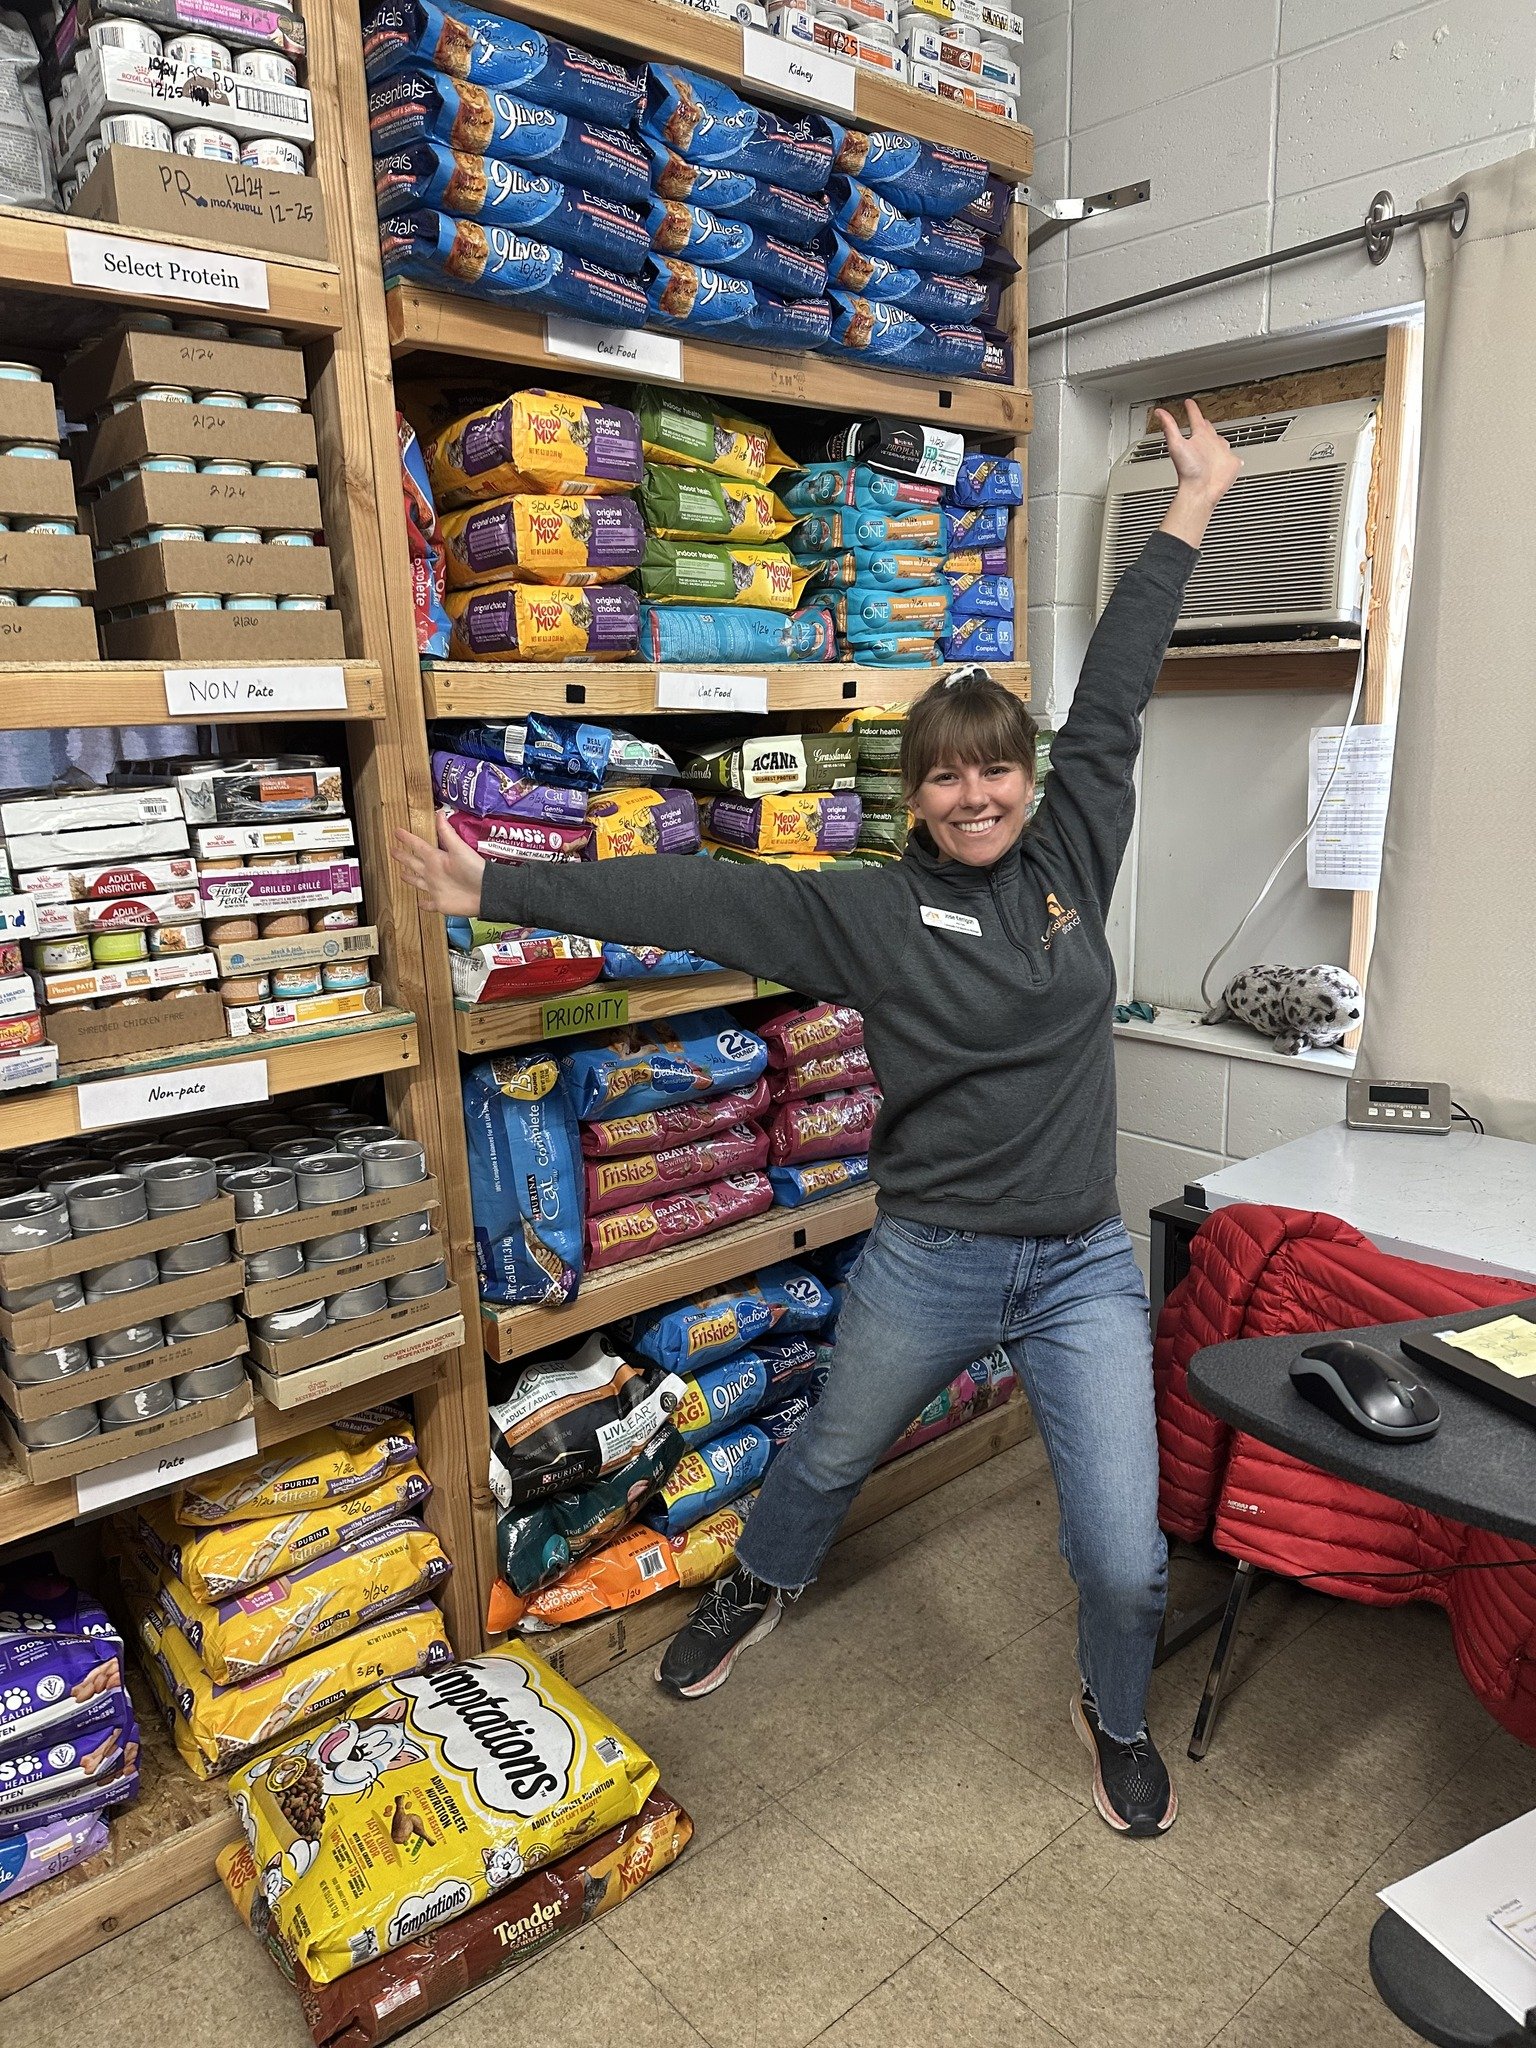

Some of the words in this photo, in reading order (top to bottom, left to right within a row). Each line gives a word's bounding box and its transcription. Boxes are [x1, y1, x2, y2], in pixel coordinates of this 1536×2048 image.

[788, 62, 814, 82] Kidney
[370, 79, 428, 112] Essentials
[493, 93, 556, 140] 9Lives
[490, 160, 550, 206] 9Lives
[695, 207, 743, 244] 9Lives
[491, 228, 551, 273] 9Lives
[103, 252, 163, 280] Select
[168, 261, 240, 290] Protein
[700, 267, 749, 306] 9Lives
[597, 341, 614, 356] Cat
[616, 344, 637, 361] Food
[528, 410, 561, 430] Meow
[594, 418, 621, 429] original
[535, 428, 557, 446] Mix
[595, 426, 620, 437] choice
[871, 481, 895, 496] ONE
[530, 510, 562, 529] Meow
[596, 508, 622, 519] original
[597, 517, 621, 526] choice
[536, 528, 559, 546] Mix
[858, 524, 885, 539] ONE
[978, 533, 997, 541] Complete
[676, 549, 698, 559] indoor
[698, 551, 719, 560] health
[766, 557, 792, 579] Meow
[872, 561, 896, 575] ONE
[414, 558, 427, 607] omplete
[530, 601, 562, 618] Meow
[595, 596, 621, 606] original
[597, 604, 621, 613] choice
[975, 598, 998, 606] Complete
[863, 607, 889, 620] ONE
[536, 615, 559, 632] Mix
[189, 681, 240, 702] NON
[246, 684, 275, 698] Pate
[698, 686, 711, 698] Cat
[714, 687, 732, 698] Food
[859, 726, 879, 735] indoor
[879, 727, 900, 736] health
[587, 737, 602, 746] REAL
[752, 752, 798, 771] ACANA
[813, 748, 851, 763] Grasslands
[441, 759, 453, 791] PURINA
[777, 774, 798, 782] PROTEIN
[461, 769, 475, 805] Gentle
[545, 790, 563, 801] Cat
[544, 804, 563, 814] Gentle
[660, 809, 682, 821] original
[773, 807, 801, 826] Meow
[827, 806, 848, 815] original
[827, 813, 846, 822] choice
[872, 812, 892, 821] health
[662, 818, 682, 828] choice
[489, 825, 536, 843] IAMS
[608, 827, 634, 844] Meow
[488, 842, 514, 854] URINARY
[516, 849, 532, 858] TRACT
[532, 852, 550, 860] HEALTH
[108, 873, 135, 883] ADULT
[98, 882, 147, 894] INSTINCTIVE
[210, 884, 247, 897] Fancy
[260, 885, 291, 894] GRILLED
[298, 881, 321, 892] GRILLÉ
[102, 914, 151, 927] INSTINCTIVE
[112, 907, 139, 918] ADULT
[78, 1023, 119, 1036] SHREDDED
[124, 1016, 160, 1027] CHICKEN
[164, 1012, 185, 1020] FARE
[547, 1000, 623, 1031] PRIORITY
[719, 1033, 756, 1054] 22
[653, 1065, 692, 1078] Seafood
[148, 1082, 206, 1102] Non-pate
[509, 1073, 532, 1093] 25
[528, 1104, 549, 1167] Complete
[656, 1148, 694, 1162] GRAVY
[492, 1161, 500, 1181] Complete
[602, 1163, 655, 1188] Friskies
[528, 1175, 540, 1213] PURINA
[540, 1176, 560, 1221] Cat
[655, 1200, 689, 1219] GRAVY
[603, 1216, 655, 1243] Friskies
[691, 1320, 736, 1350] Friskies
[384, 1349, 406, 1361] CHICKEN
[407, 1343, 422, 1354] LIVER
[781, 1340, 808, 1360] Daily
[773, 1348, 816, 1374] Essentials
[713, 1367, 758, 1422] 9Lives
[505, 1407, 528, 1426] ADULT
[533, 1389, 558, 1408] ADULTE
[780, 1395, 810, 1421] Daily
[157, 1455, 185, 1473] Pate
[552, 1464, 585, 1481] PURINA
[284, 1477, 319, 1491] PURINA
[330, 1477, 355, 1489] Healthy
[408, 1478, 423, 1493] 14
[525, 1481, 560, 1499] PRO
[273, 1486, 320, 1504] Kitten
[341, 1520, 363, 1536] Healthy
[362, 1506, 396, 1527] Development
[583, 1508, 608, 1533] INSTINCT
[701, 1512, 739, 1539] Meow
[298, 1528, 330, 1547] PURINA
[374, 1533, 387, 1545] Real
[290, 1539, 332, 1564] Kitten
[429, 1559, 444, 1574] 14
[14, 1639, 44, 1653] 100%
[429, 1644, 444, 1659] 14
[313, 1691, 346, 1709] PURINA
[5, 1771, 43, 1790] HEALTH
[411, 1786, 424, 1804] CATS
[5, 1802, 39, 1816] KITTEN
[425, 1787, 452, 1830] NUTRITION
[430, 1774, 448, 1798] ADULT
[443, 1794, 469, 1835] COMPLETE
[531, 1817, 551, 1832] ADULT
[583, 1777, 615, 1802] NUTRITION
[361, 1831, 381, 1859] FLAVOR
[365, 1818, 380, 1838] TASTY
[375, 1836, 396, 1866] CHICKEN
[48, 1846, 82, 1875] 8/25
[619, 1859, 651, 1893] Mix
[393, 1886, 468, 1938] Temptations
[494, 1899, 563, 1947] Tender
[509, 1920, 554, 1950] CENTERS
